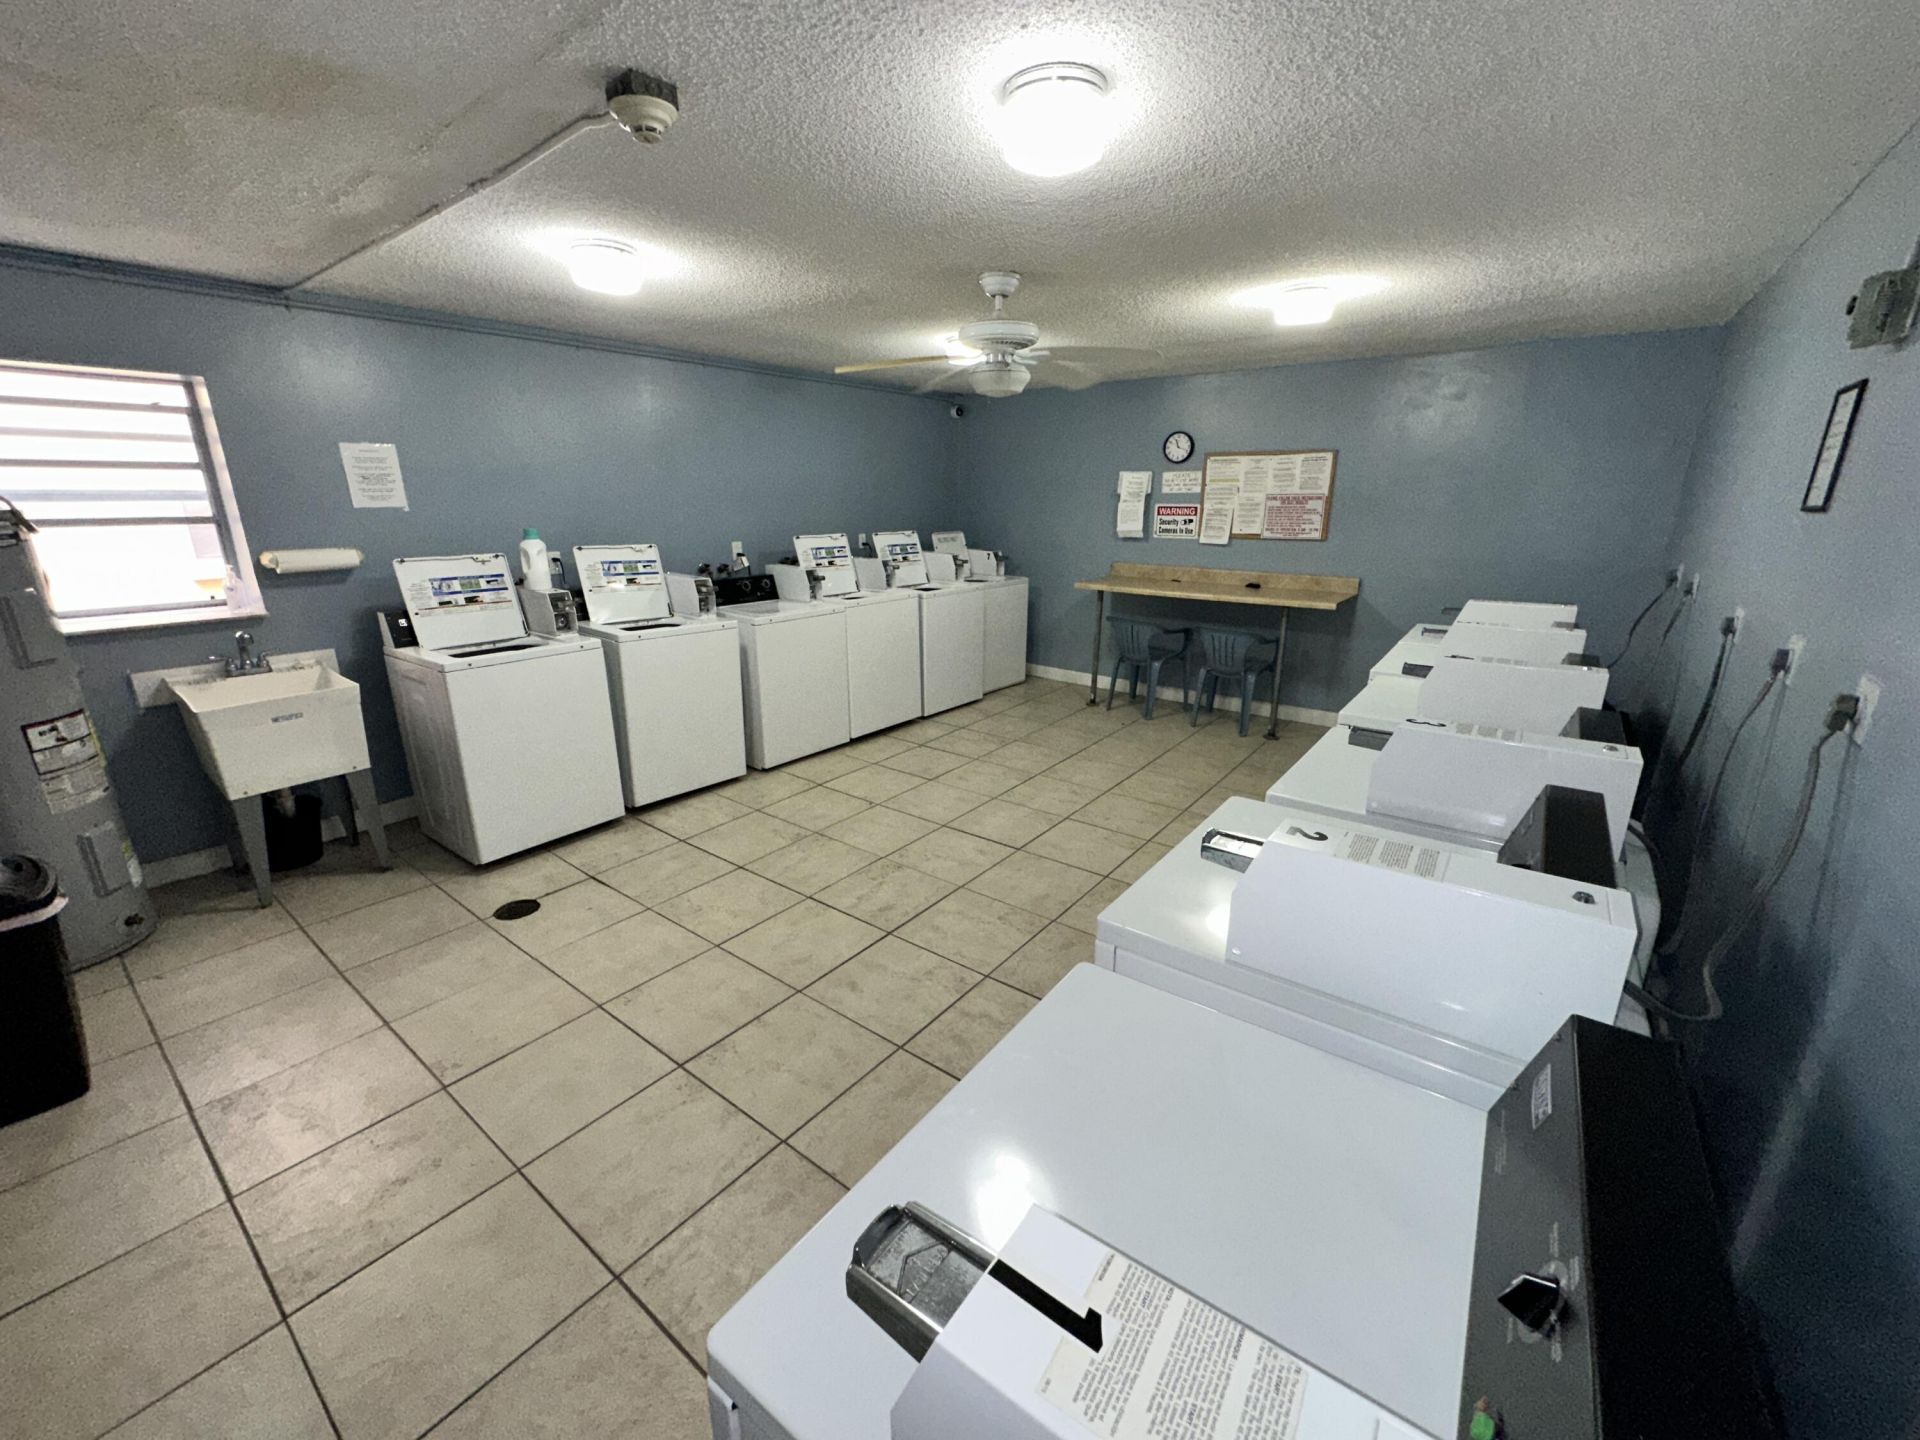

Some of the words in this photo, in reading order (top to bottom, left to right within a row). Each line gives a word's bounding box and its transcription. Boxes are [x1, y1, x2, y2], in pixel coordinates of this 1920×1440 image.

[1159, 518, 1178, 526] Security
[1286, 826, 1328, 841] 2
[988, 1258, 1103, 1353] 1
